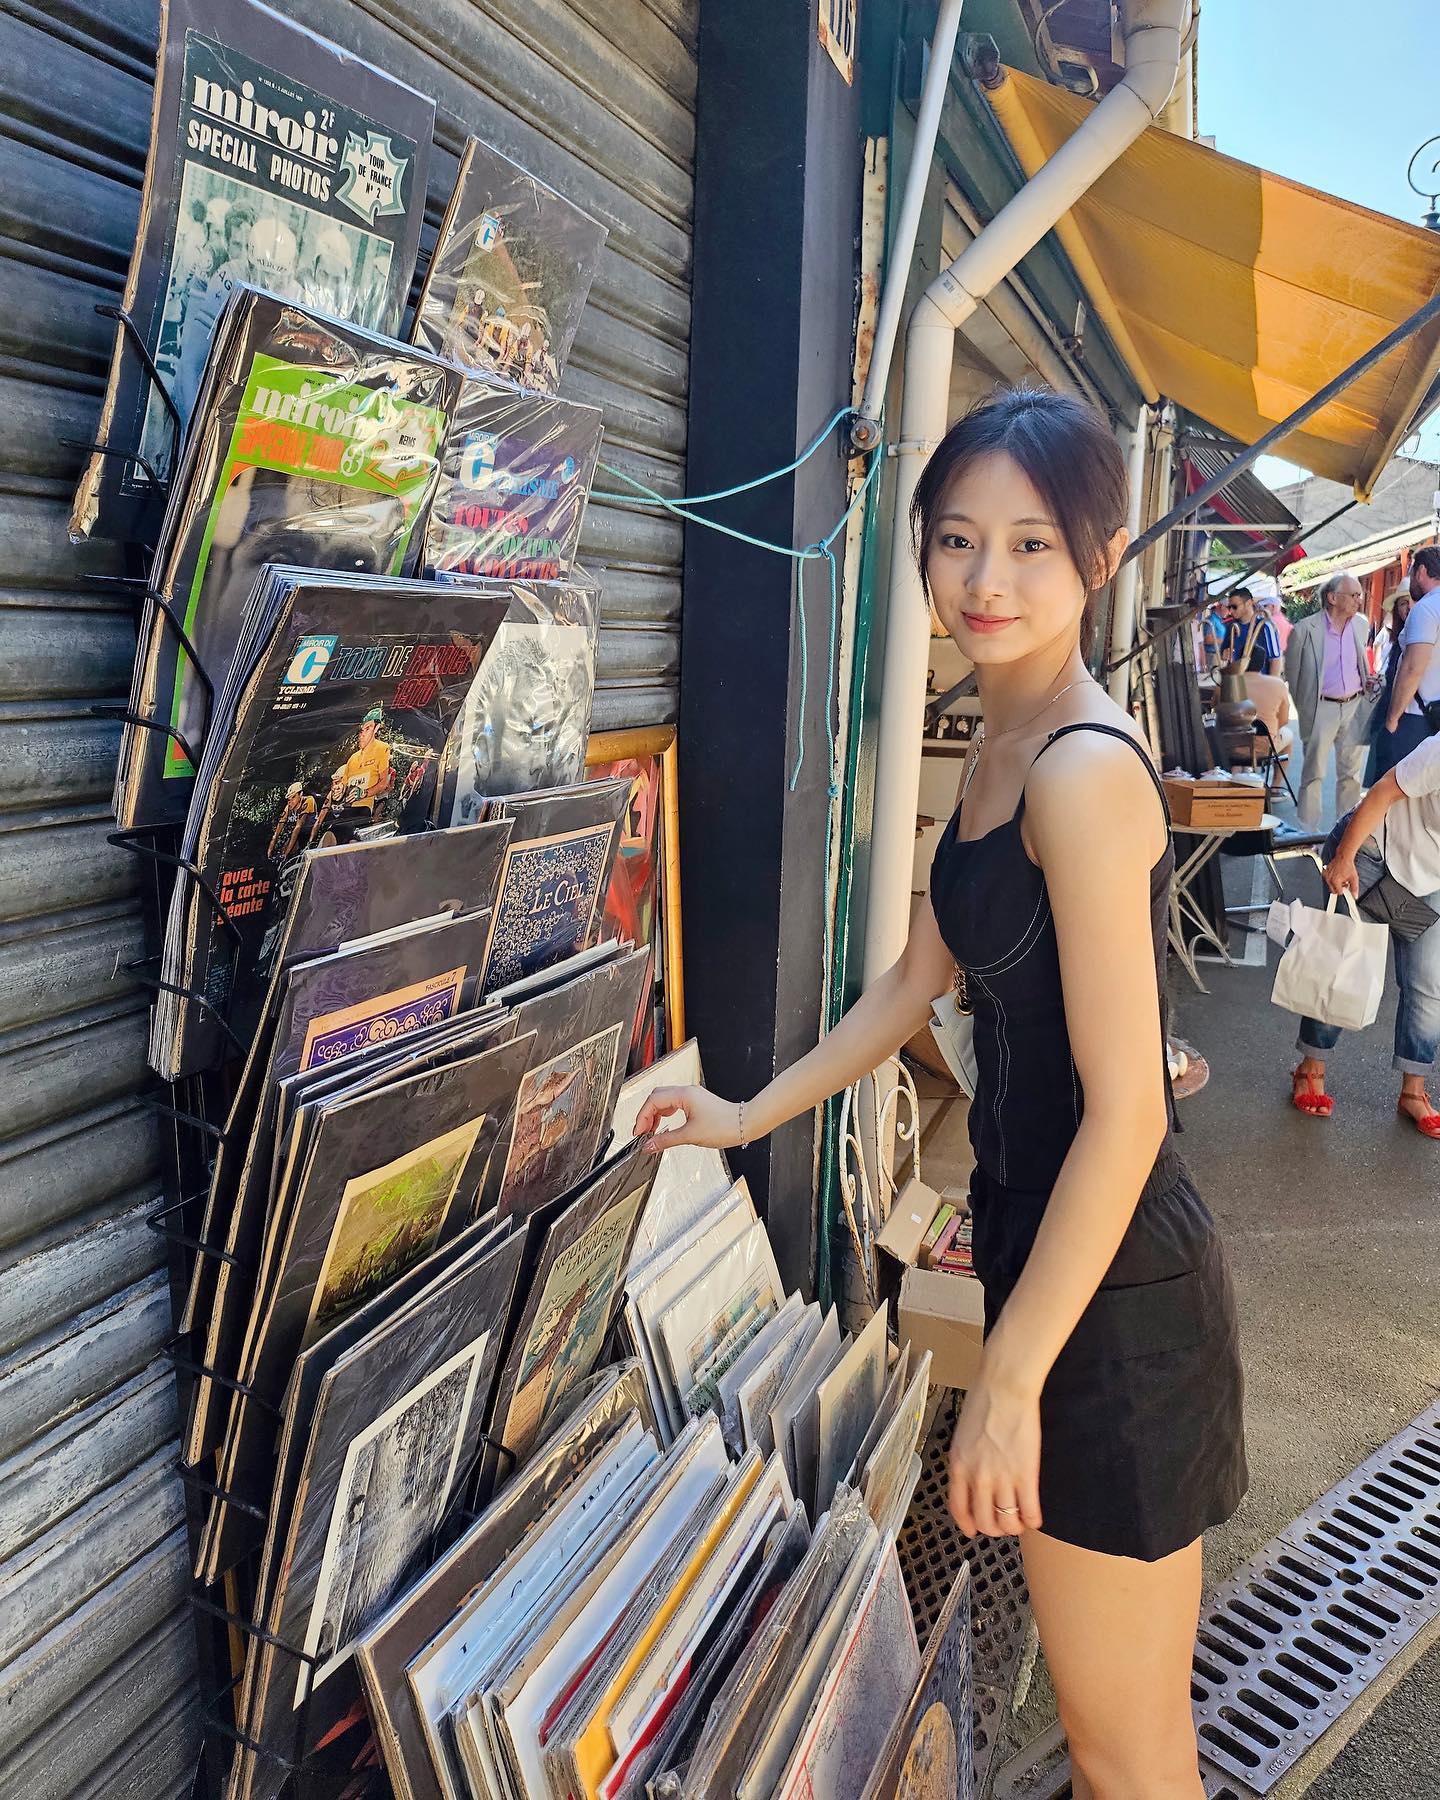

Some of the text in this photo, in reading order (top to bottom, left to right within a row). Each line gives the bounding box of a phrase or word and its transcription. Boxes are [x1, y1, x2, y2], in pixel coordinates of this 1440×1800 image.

[192, 75, 338, 165] miroir
[321, 109, 336, 131] 2F
[187, 119, 332, 203] SPECIAL PHOTOS
[369, 153, 386, 172] TOUR
[358, 163, 393, 190] DE FRANCE
[376, 187, 381, 199] 2
[249, 383, 368, 442] miroir
[303, 639, 335, 647] MIROIR DU
[330, 644, 478, 681] TOUR DE FRANCE
[279, 686, 317, 695] YCLISME
[391, 677, 439, 711] 1970
[222, 866, 255, 888] avec
[220, 879, 271, 905] la carte
[529, 880, 585, 915] LE CIEL
[451, 971, 457, 983] 7
[554, 1217, 607, 1270] NOUVEAU
[565, 1216, 622, 1277] LAROUSSE
